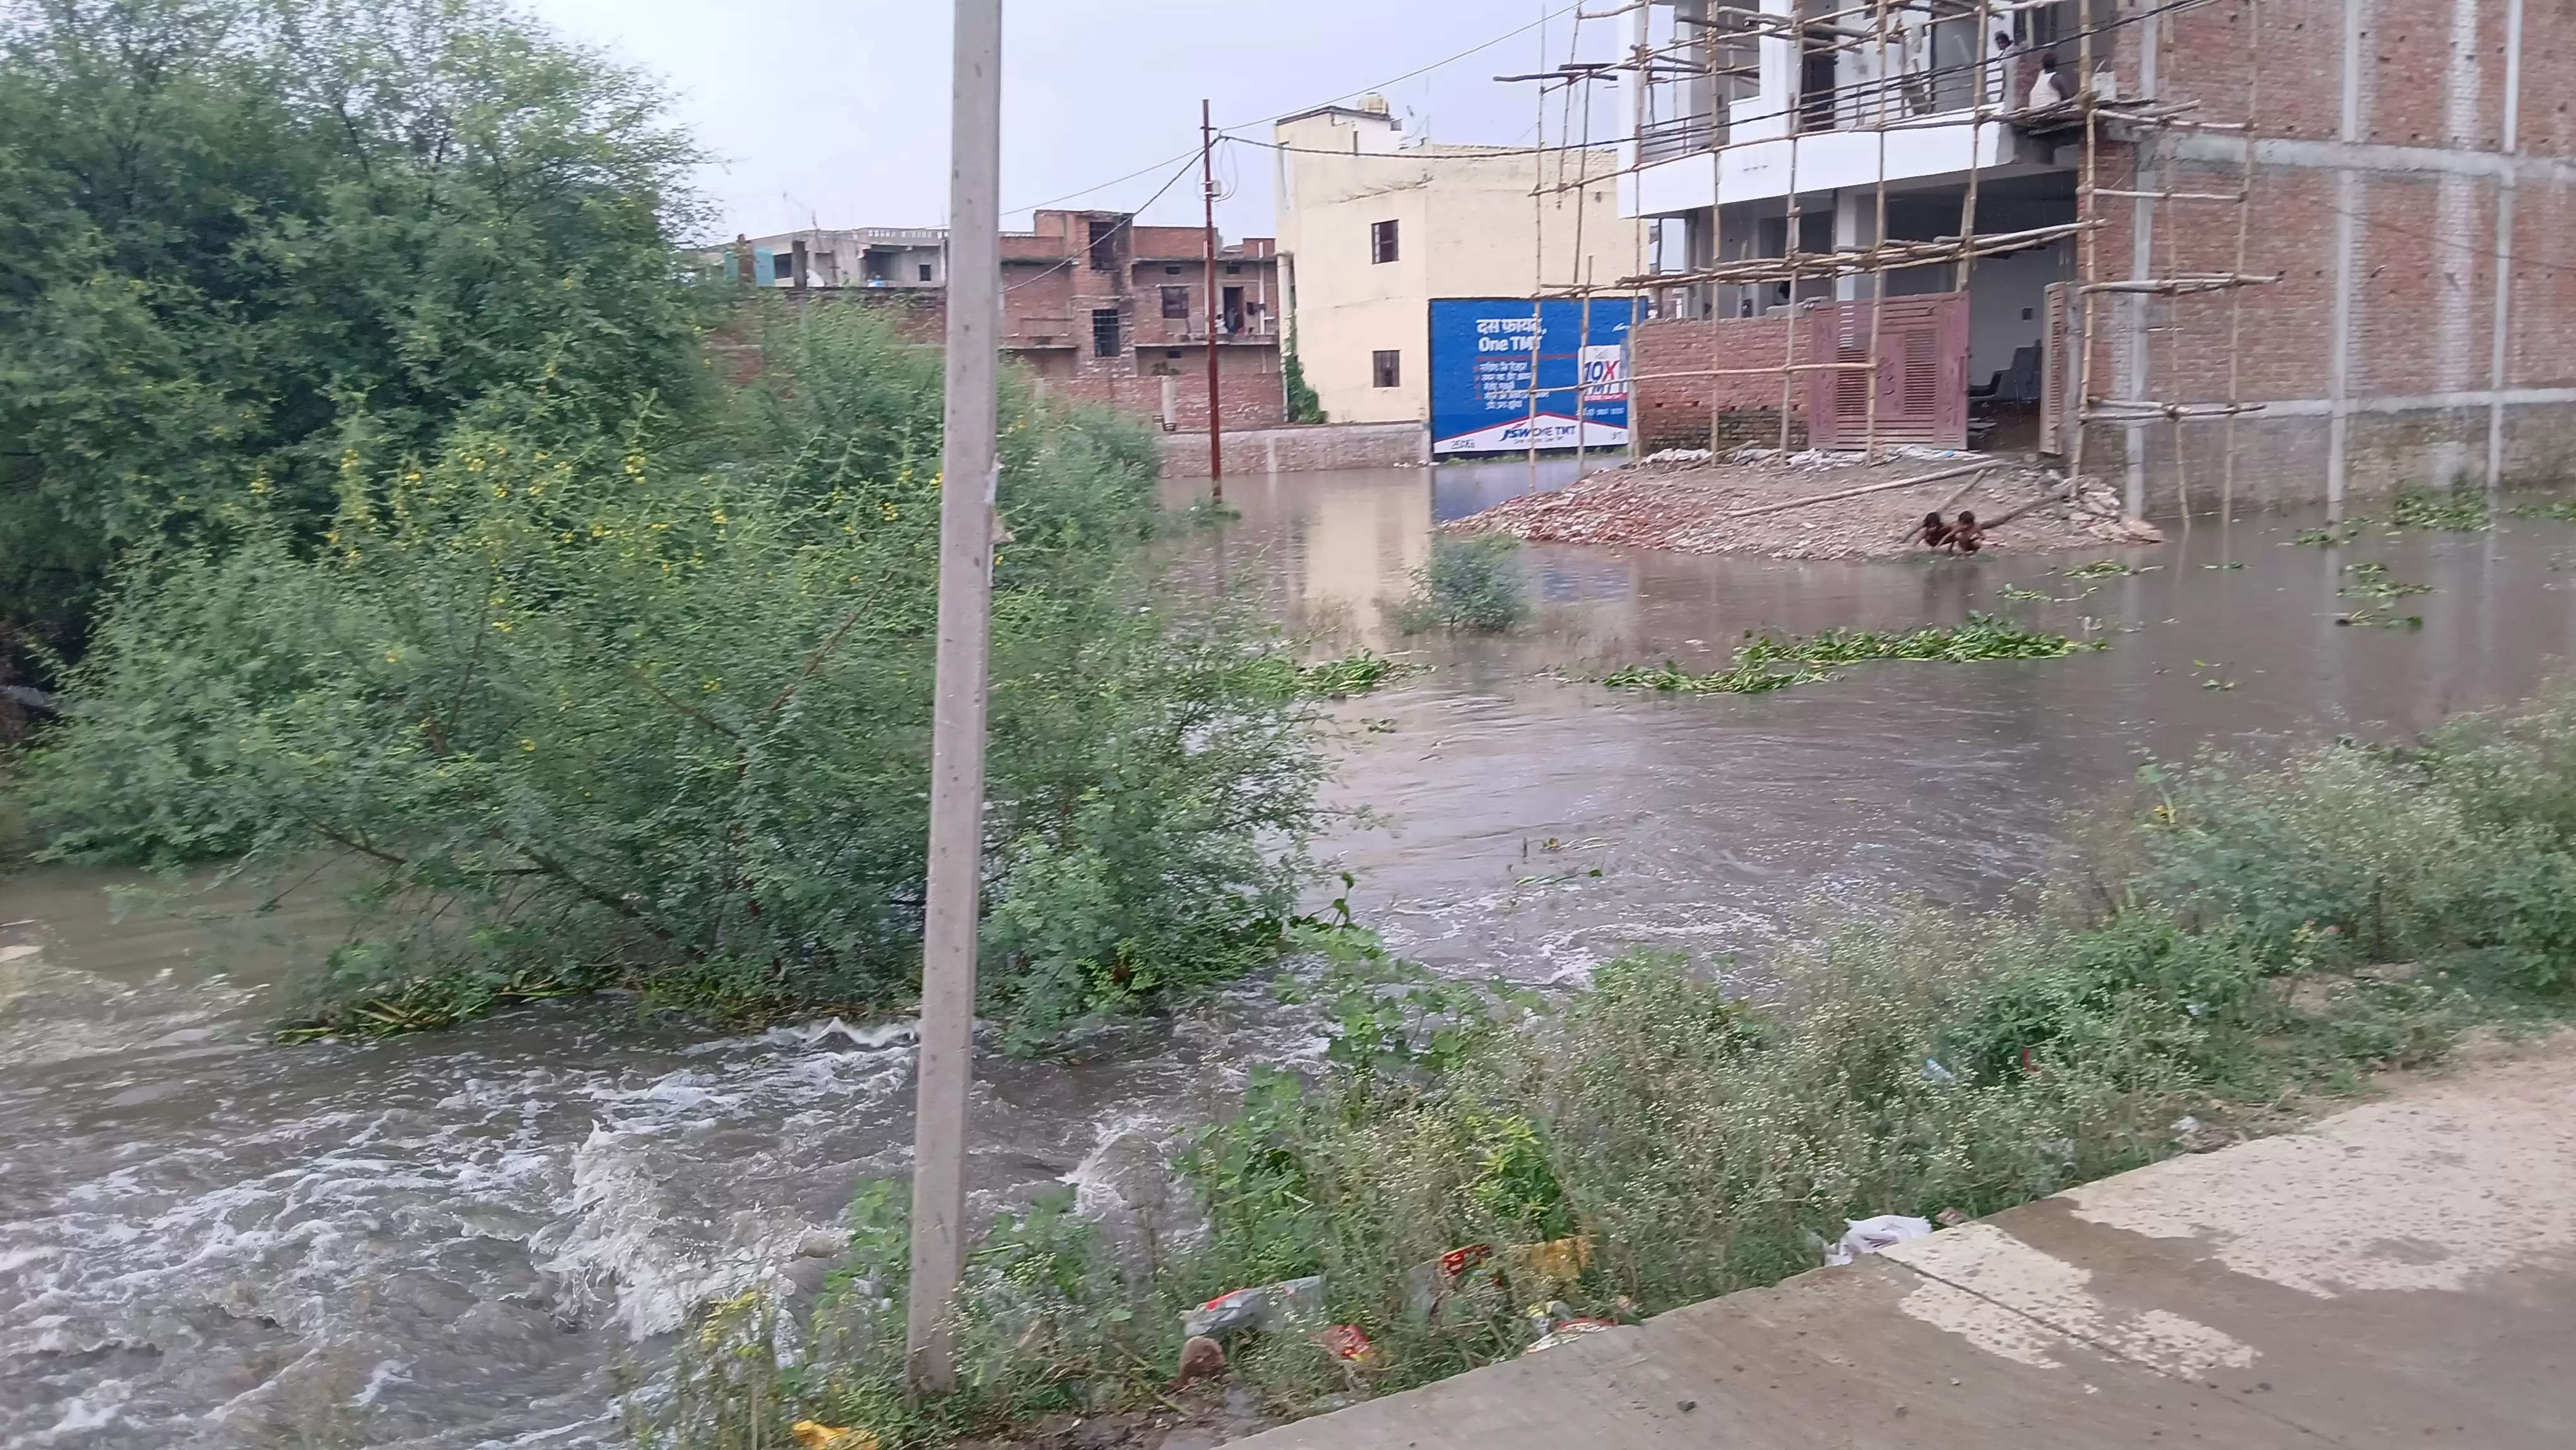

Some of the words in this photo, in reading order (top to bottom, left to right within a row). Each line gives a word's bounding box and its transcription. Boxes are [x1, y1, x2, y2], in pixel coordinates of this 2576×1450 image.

[1476, 318, 1501, 334] दस
[1479, 337, 1509, 352] One
[1510, 335, 1543, 351] TMT
[1584, 360, 1620, 382] 10X
[1498, 428, 1531, 441] JSW
